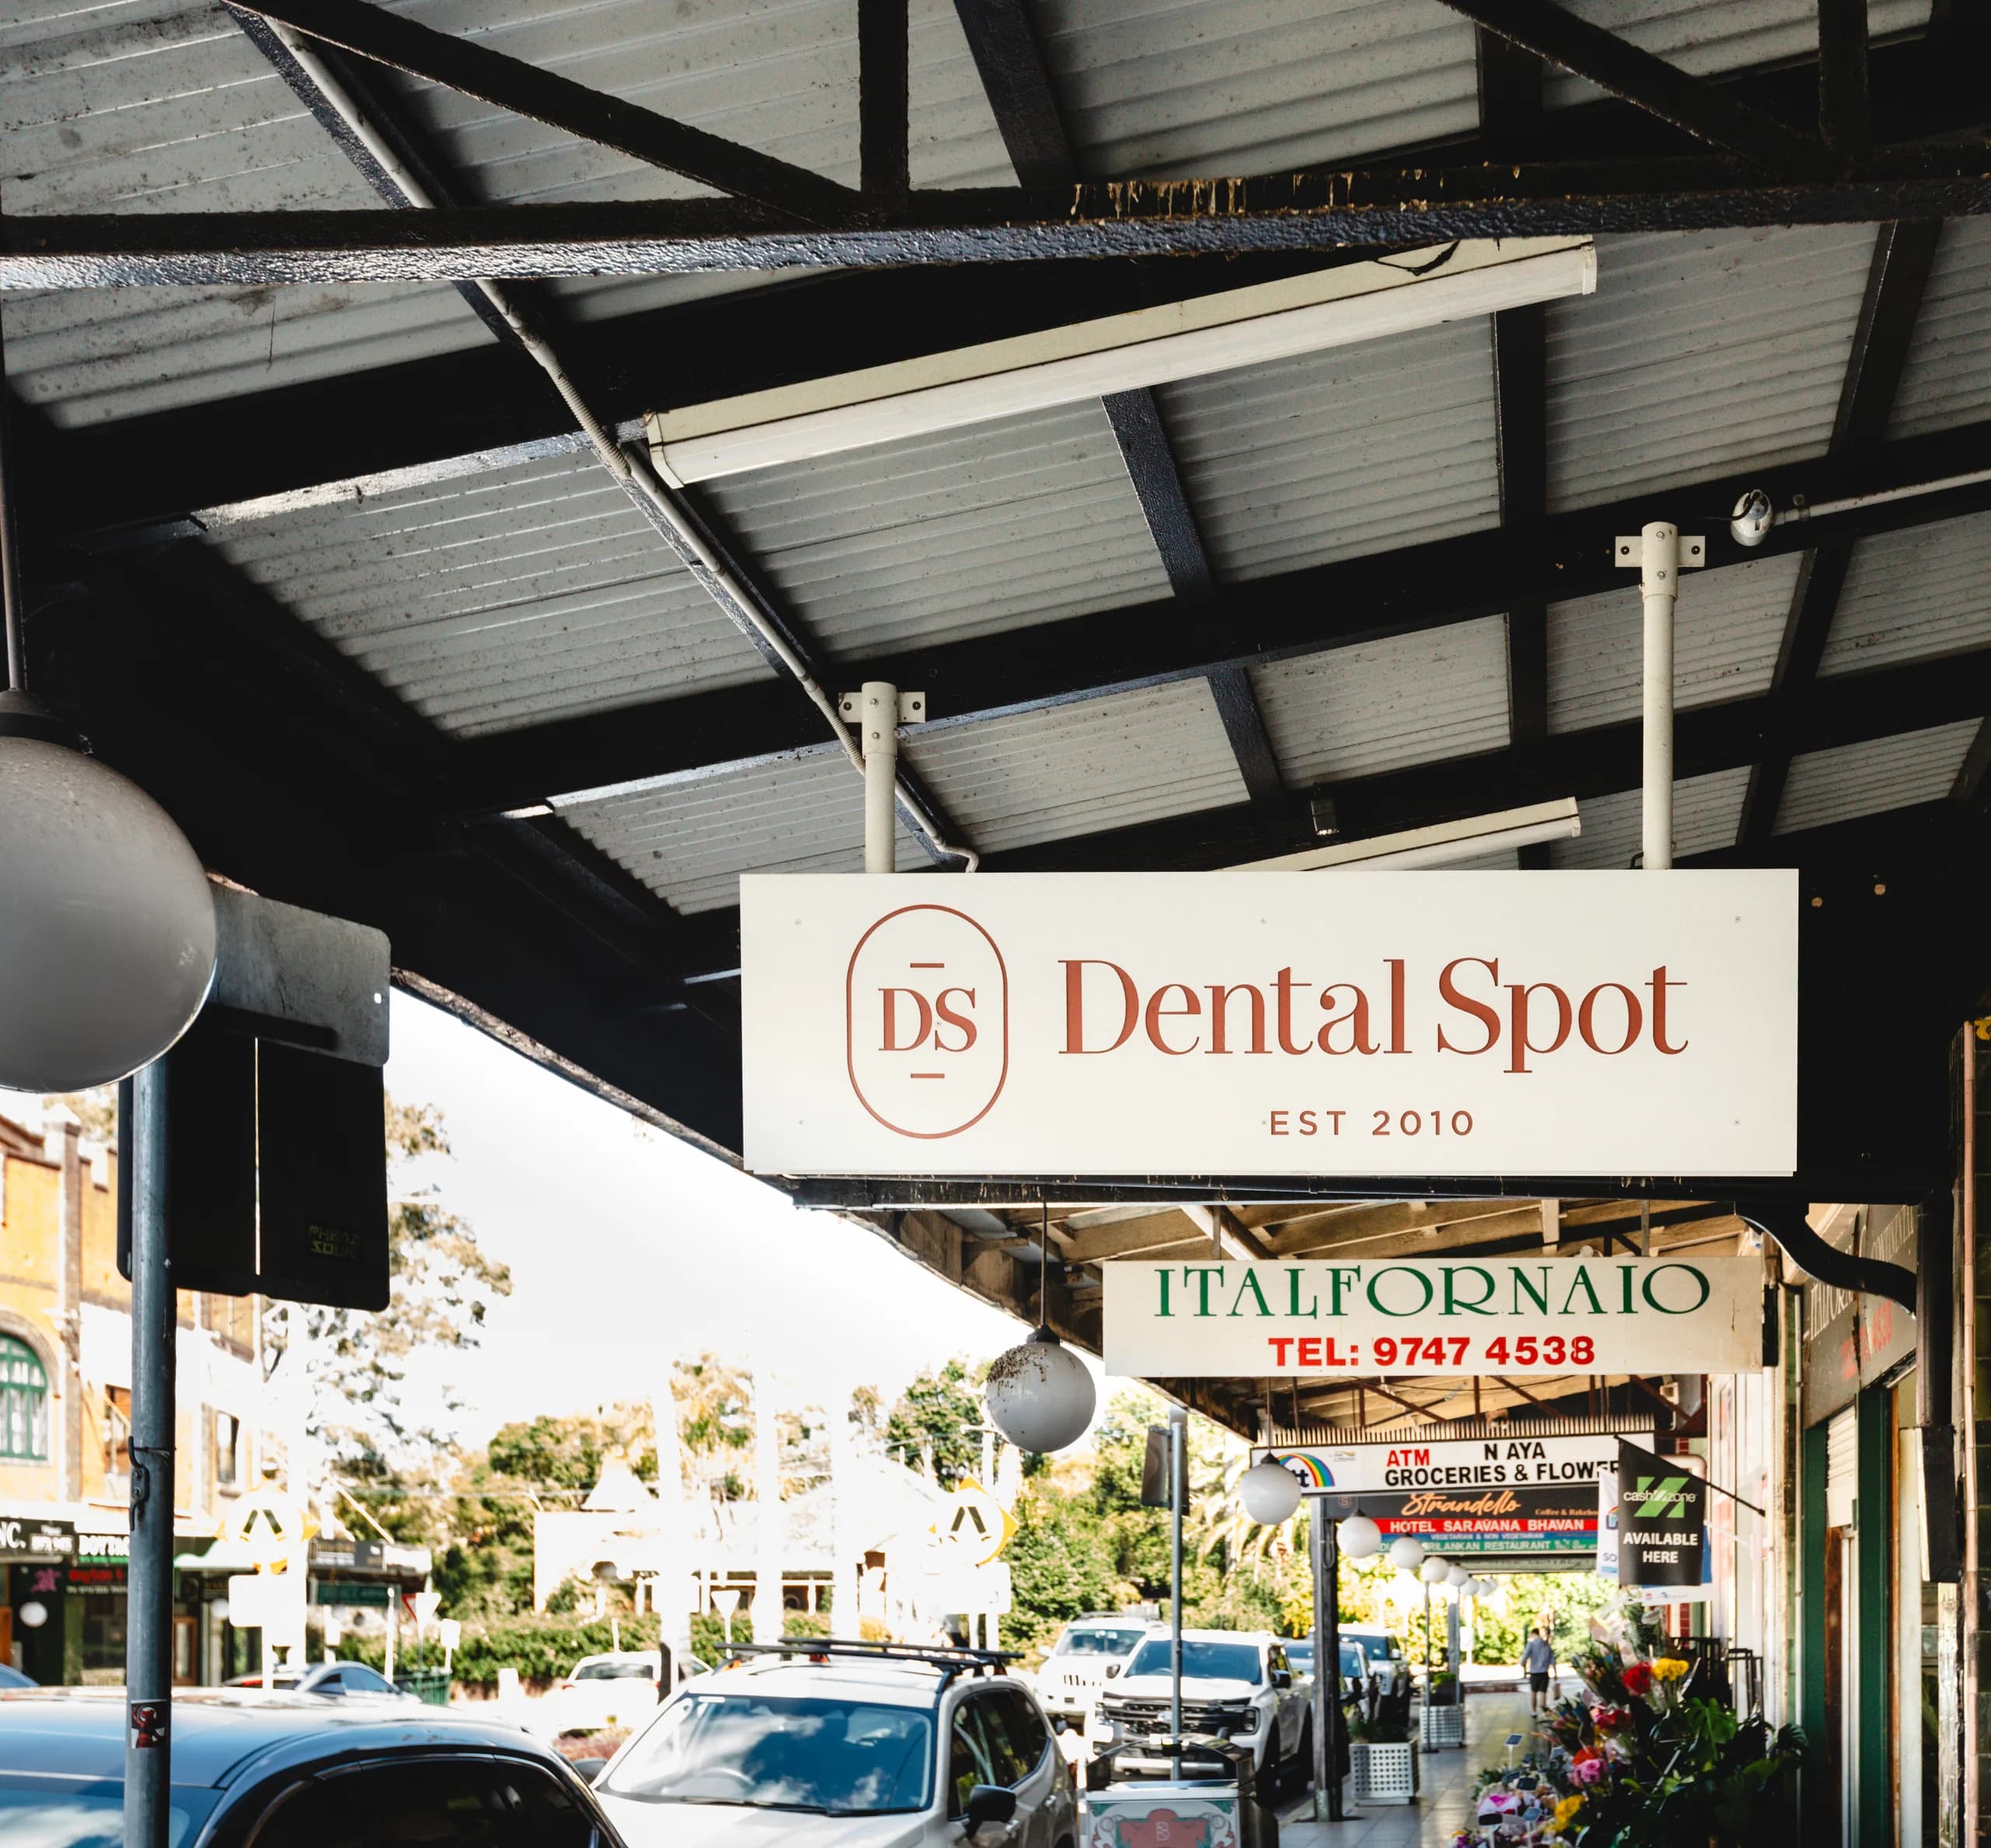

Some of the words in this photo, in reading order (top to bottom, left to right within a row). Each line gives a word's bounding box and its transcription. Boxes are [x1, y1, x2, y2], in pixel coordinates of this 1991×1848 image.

[877, 986, 978, 1052] DS
[1058, 958, 1412, 1055] Dental
[1437, 957, 1688, 1073] Spot
[1271, 1110, 1346, 1136] EST
[1373, 1110, 1475, 1136] 2010
[1153, 1264, 1710, 1318] ITALFORNAIO
[1268, 1337, 1359, 1367] TEL:
[1373, 1336, 1471, 1367] 9747
[1485, 1335, 1595, 1366] 4538
[1387, 1448, 1430, 1467] ATM
[1484, 1443, 1498, 1461] N
[1506, 1441, 1546, 1460] AYA
[1384, 1465, 1506, 1486] GROCERIES
[1513, 1464, 1528, 1482] &
[1401, 1490, 1521, 1516] Strandello
[1390, 1521, 1436, 1533] HOTEL
[1443, 1519, 1520, 1532] SARAVANA
[1527, 1519, 1584, 1531] BHAVAN
[1622, 1531, 1699, 1546] AVAILABLE
[1484, 1541, 1551, 1550] RESTAURANT
[1642, 1550, 1679, 1563] HERE
